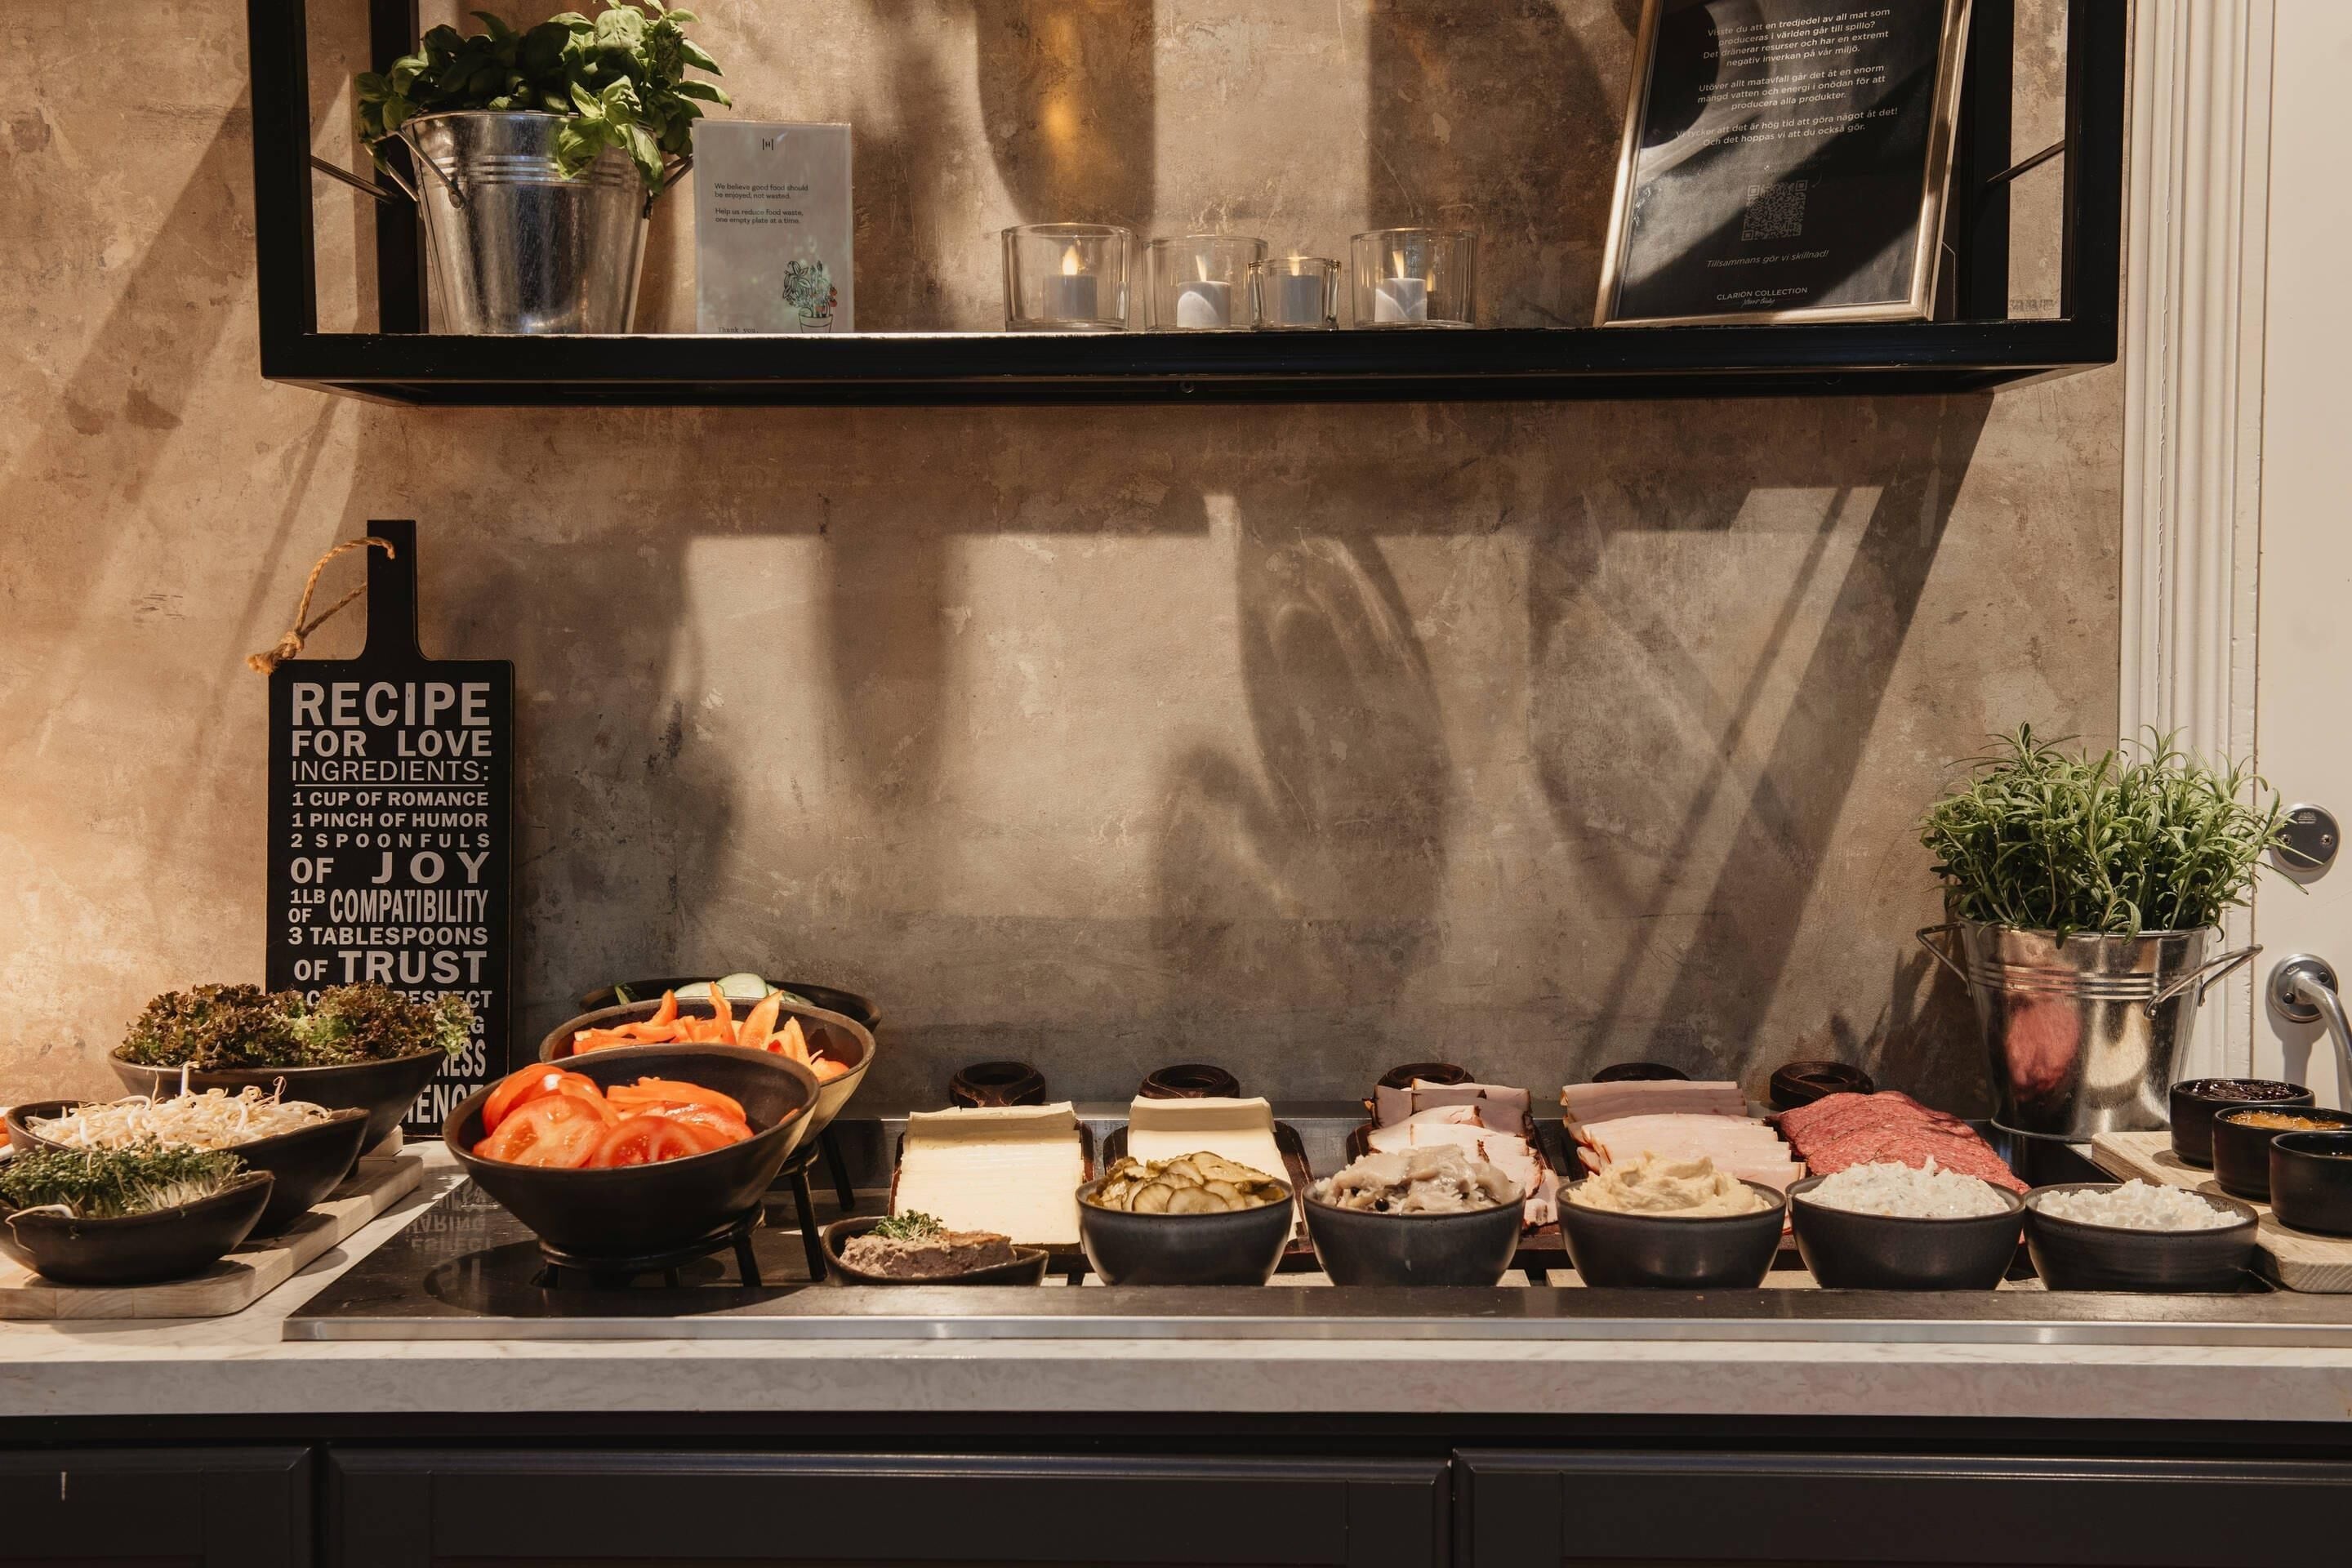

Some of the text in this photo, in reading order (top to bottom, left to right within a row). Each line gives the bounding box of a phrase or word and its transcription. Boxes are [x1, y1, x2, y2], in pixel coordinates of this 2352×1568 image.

[1708, 28, 1733, 37] Visste
[1736, 24, 1748, 33] du
[1750, 24, 1763, 32] att
[1780, 16, 1820, 29] tredjedel
[1836, 13, 1846, 21] all
[1870, 9, 1890, 17] som
[1718, 33, 1768, 47] produceras
[1776, 29, 1811, 38] världen
[1813, 25, 1829, 36] går
[1845, 21, 1875, 32] spillo?
[1722, 46, 1759, 56] dränerar
[1762, 42, 1798, 51] resurser
[1820, 37, 1835, 45] har
[1852, 31, 1889, 41] extremt
[1726, 44, 1860, 67] negativ inverkan på vår miljö.
[1698, 92, 1728, 103] mängd
[1731, 90, 1759, 99] vatten
[1762, 87, 1779, 96] och
[1781, 84, 1810, 94] energi
[1819, 78, 1854, 90] onödan
[1856, 77, 1870, 85] för
[1699, 82, 1728, 92] Utöver
[1731, 80, 1744, 88] allt
[1748, 75, 1789, 86] matavfall
[1792, 74, 1808, 83] går
[1810, 71, 1825, 79] det
[1828, 69, 1837, 78] åt
[1854, 65, 1884, 75] enorm
[1731, 91, 1846, 111] producera alla produkter.
[1687, 127, 1715, 138] tycker
[1717, 124, 1730, 133] att
[1732, 122, 1747, 131] det
[1750, 121, 1759, 131] är
[1762, 120, 1780, 130] hög
[1782, 118, 1794, 127] tid
[1797, 116, 1810, 125] att
[1813, 114, 1833, 126] göra
[1837, 111, 1864, 123] något
[1867, 109, 1877, 118] åt
[1879, 107, 1898, 117] det!
[1703, 136, 1721, 146] Och
[1723, 135, 1739, 144] det
[1741, 131, 1775, 143] hoppas
[1788, 129, 1801, 137] att
[1803, 127, 1815, 136] du
[1818, 123, 1845, 134] också
[1847, 122, 1866, 133] gör.
[1707, 250, 1829, 268] Tillsammans gör vi skillnad!
[1717, 287, 1807, 301] CLARION COLLECTION
[292, 682, 490, 726] RECIPE
[292, 730, 492, 757] FOR LOVE
[292, 760, 488, 781] INGREDIENTS:
[292, 792, 488, 807] 1 CUP OF ROMANCE
[292, 813, 488, 827] 1 PINCH OF HUMOR
[291, 833, 490, 848] 2 SPOONFULS
[291, 852, 490, 884] OF JOY
[288, 907, 312, 923] OF
[291, 889, 488, 923] 1LB COMPATIBILITY
[288, 927, 488, 945] 3 TABLESPOONS
[294, 951, 488, 983] OF TRUST
